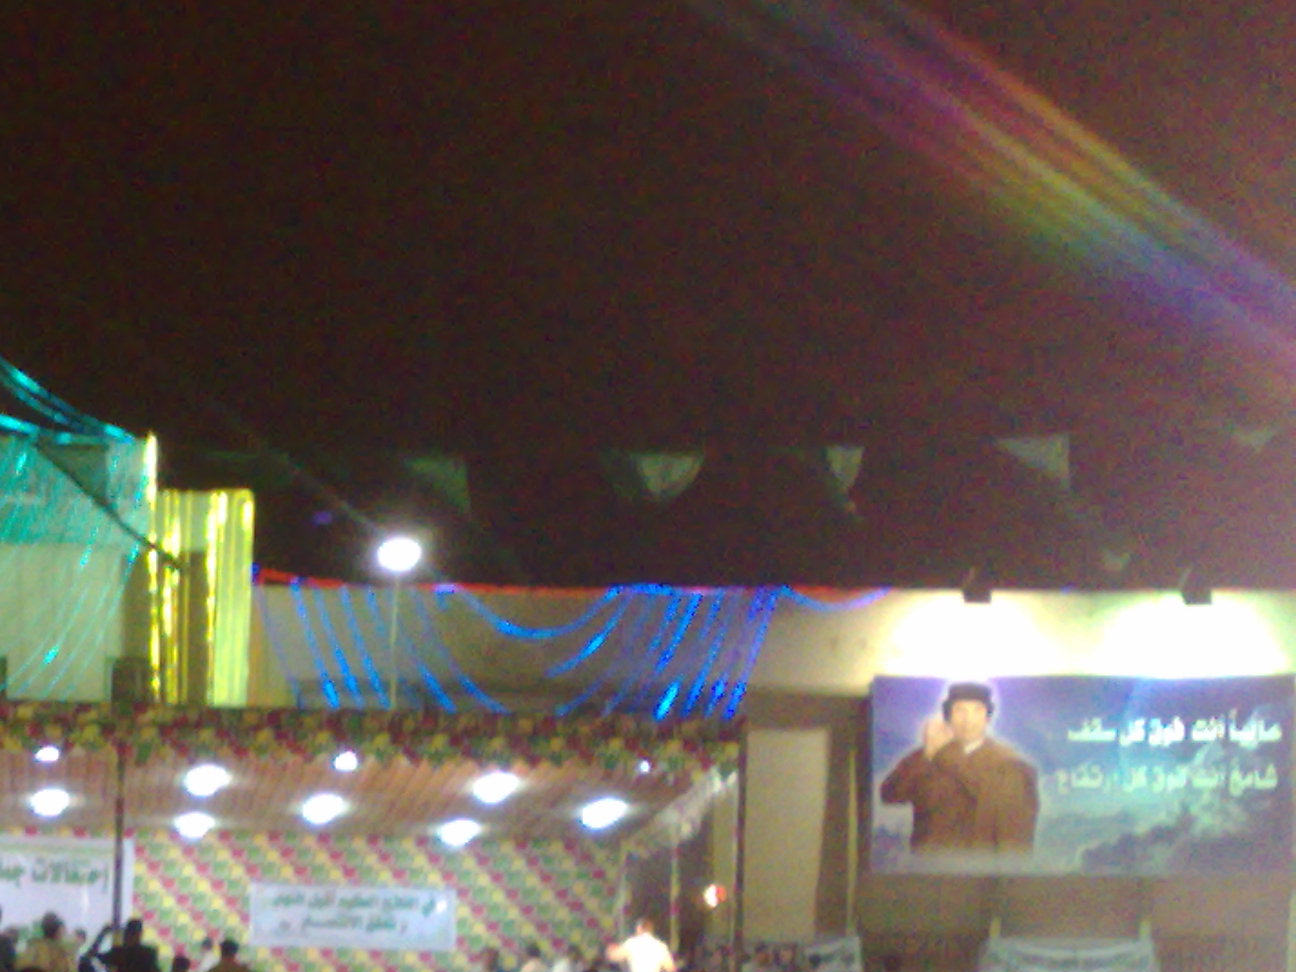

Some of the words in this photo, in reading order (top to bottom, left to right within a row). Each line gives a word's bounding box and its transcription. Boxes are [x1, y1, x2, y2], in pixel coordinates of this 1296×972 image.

[1067, 718, 1115, 742] سقف
[1119, 718, 1145, 747] كل
[1148, 716, 1184, 747] فوق
[1123, 765, 1147, 792] كل
[1151, 764, 1188, 793] فوق
